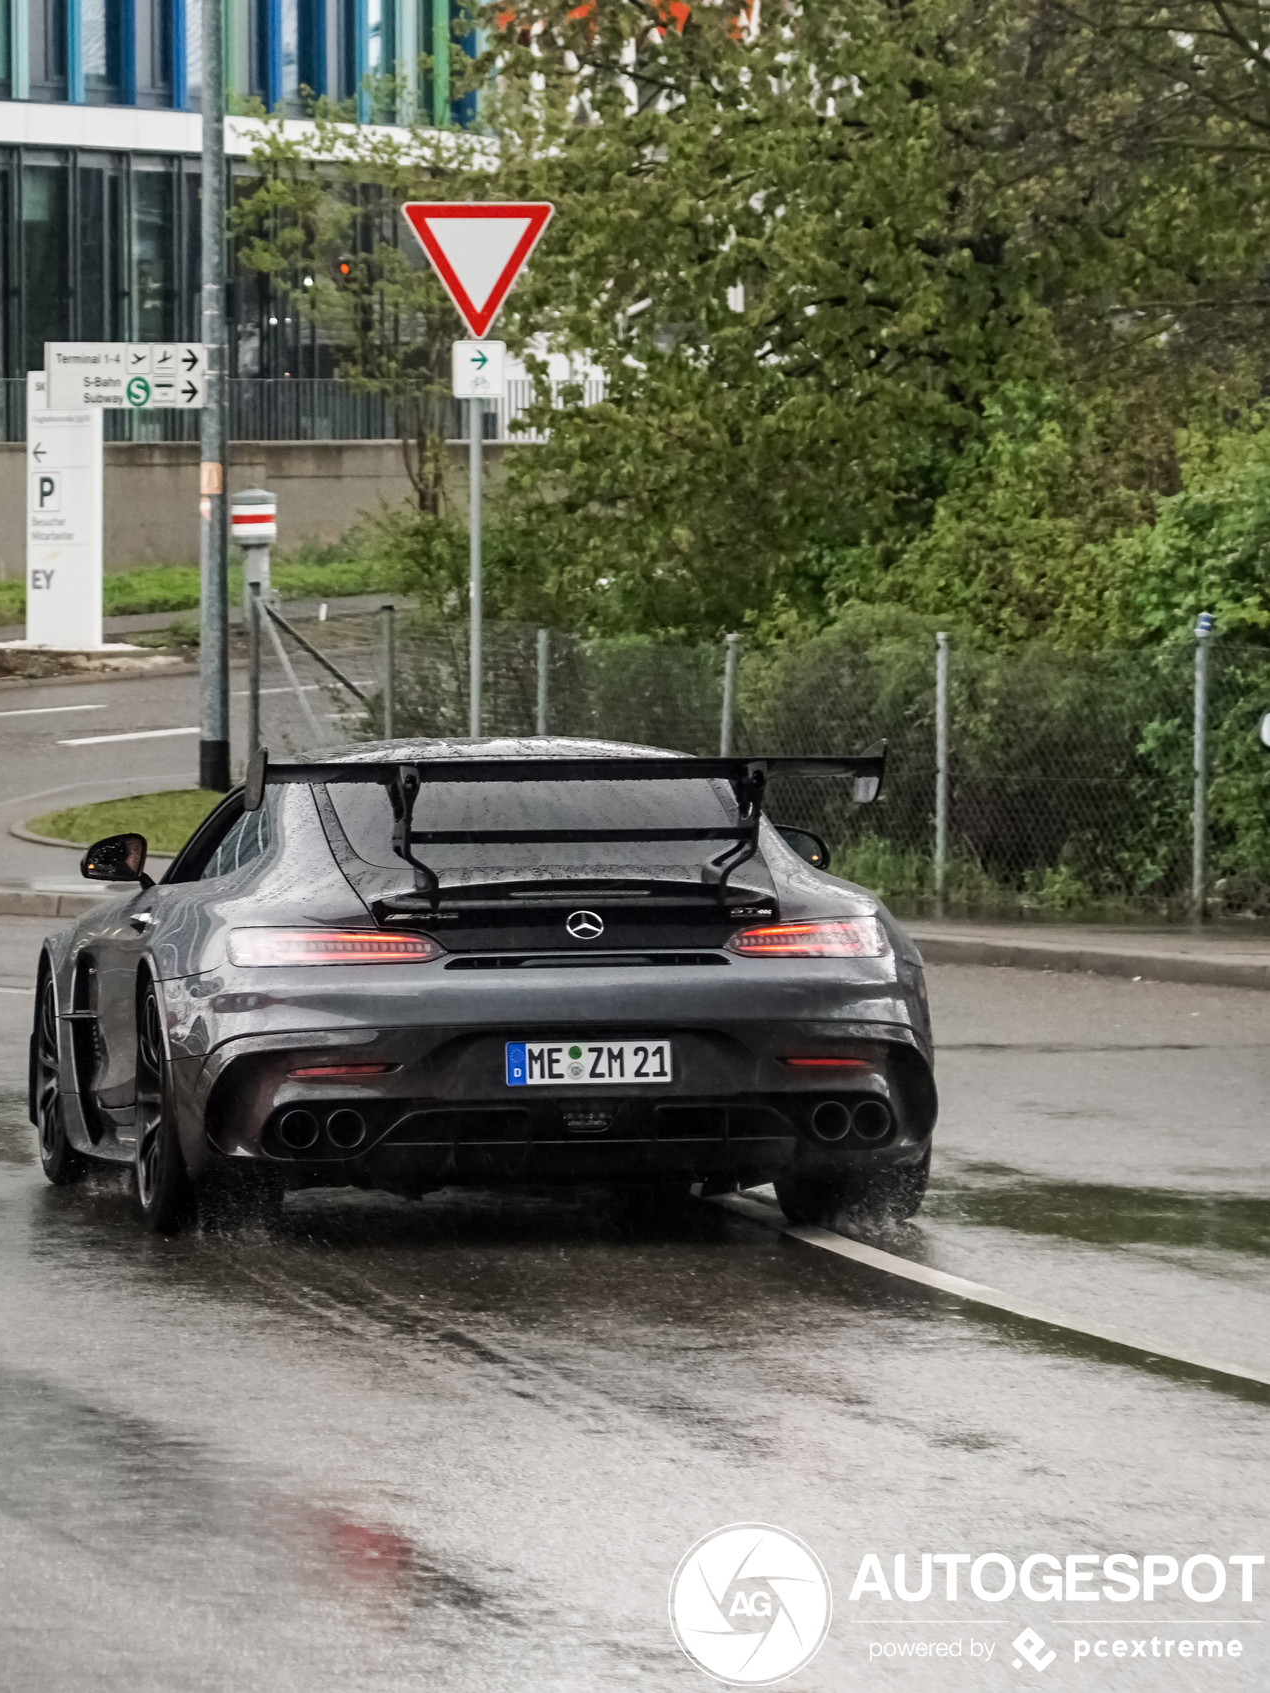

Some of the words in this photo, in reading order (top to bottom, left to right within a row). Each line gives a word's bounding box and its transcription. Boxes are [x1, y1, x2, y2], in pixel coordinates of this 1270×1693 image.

[56, 353, 101, 364] Terminal
[104, 353, 121, 364] 1-4
[83, 376, 121, 387] S-Bahn
[83, 392, 124, 405] Subway
[39, 476, 55, 508] P
[32, 569, 54, 590] EY
[513, 1067, 522, 1078] D
[527, 1047, 565, 1080] ME
[587, 1046, 625, 1078] ZM
[633, 1045, 668, 1078] 21
